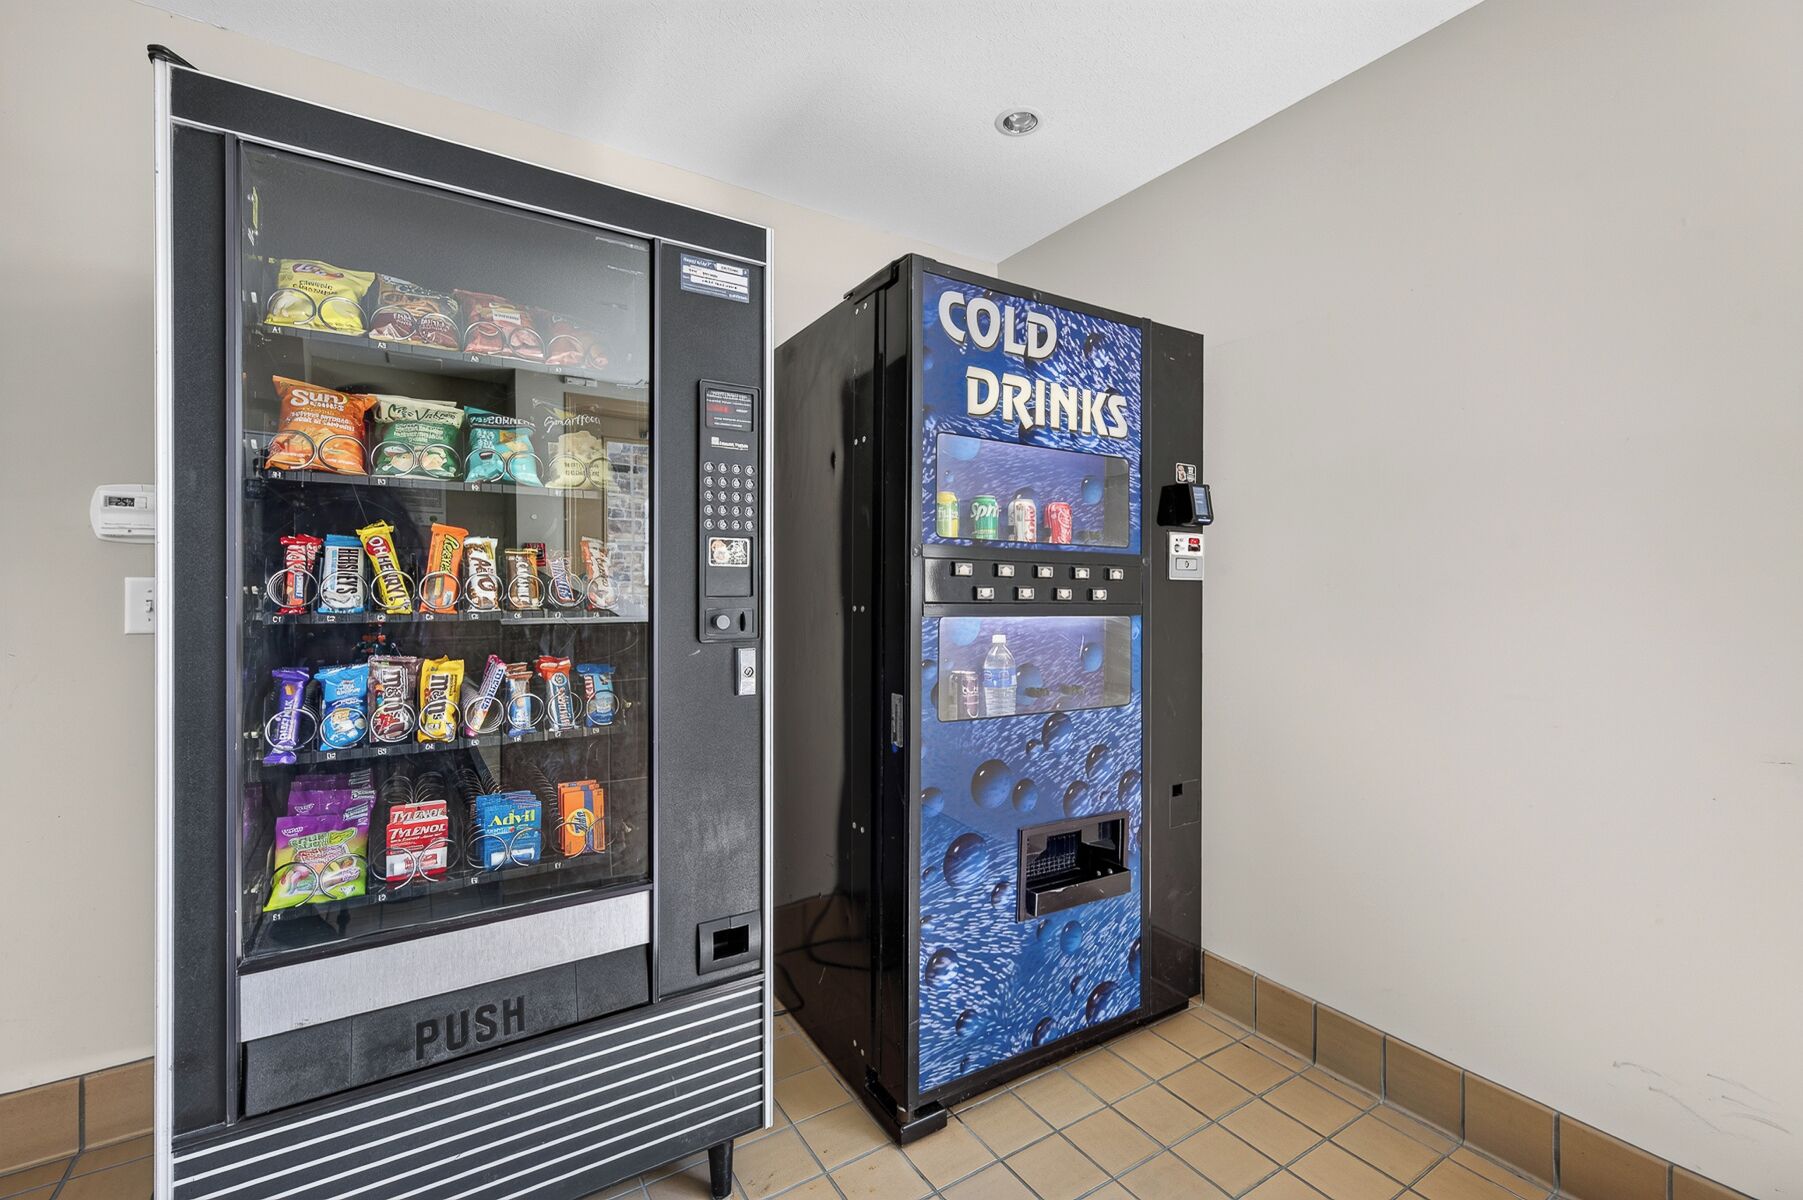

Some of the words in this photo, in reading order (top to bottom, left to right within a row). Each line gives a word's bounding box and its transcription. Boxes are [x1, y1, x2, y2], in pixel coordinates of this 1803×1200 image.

[938, 290, 1058, 360] COLD
[290, 388, 348, 407] Sun
[966, 366, 1129, 439] DRINKS
[388, 823, 446, 843] TYLENOL
[488, 808, 536, 827] Advil
[416, 995, 525, 1061] PUSH
